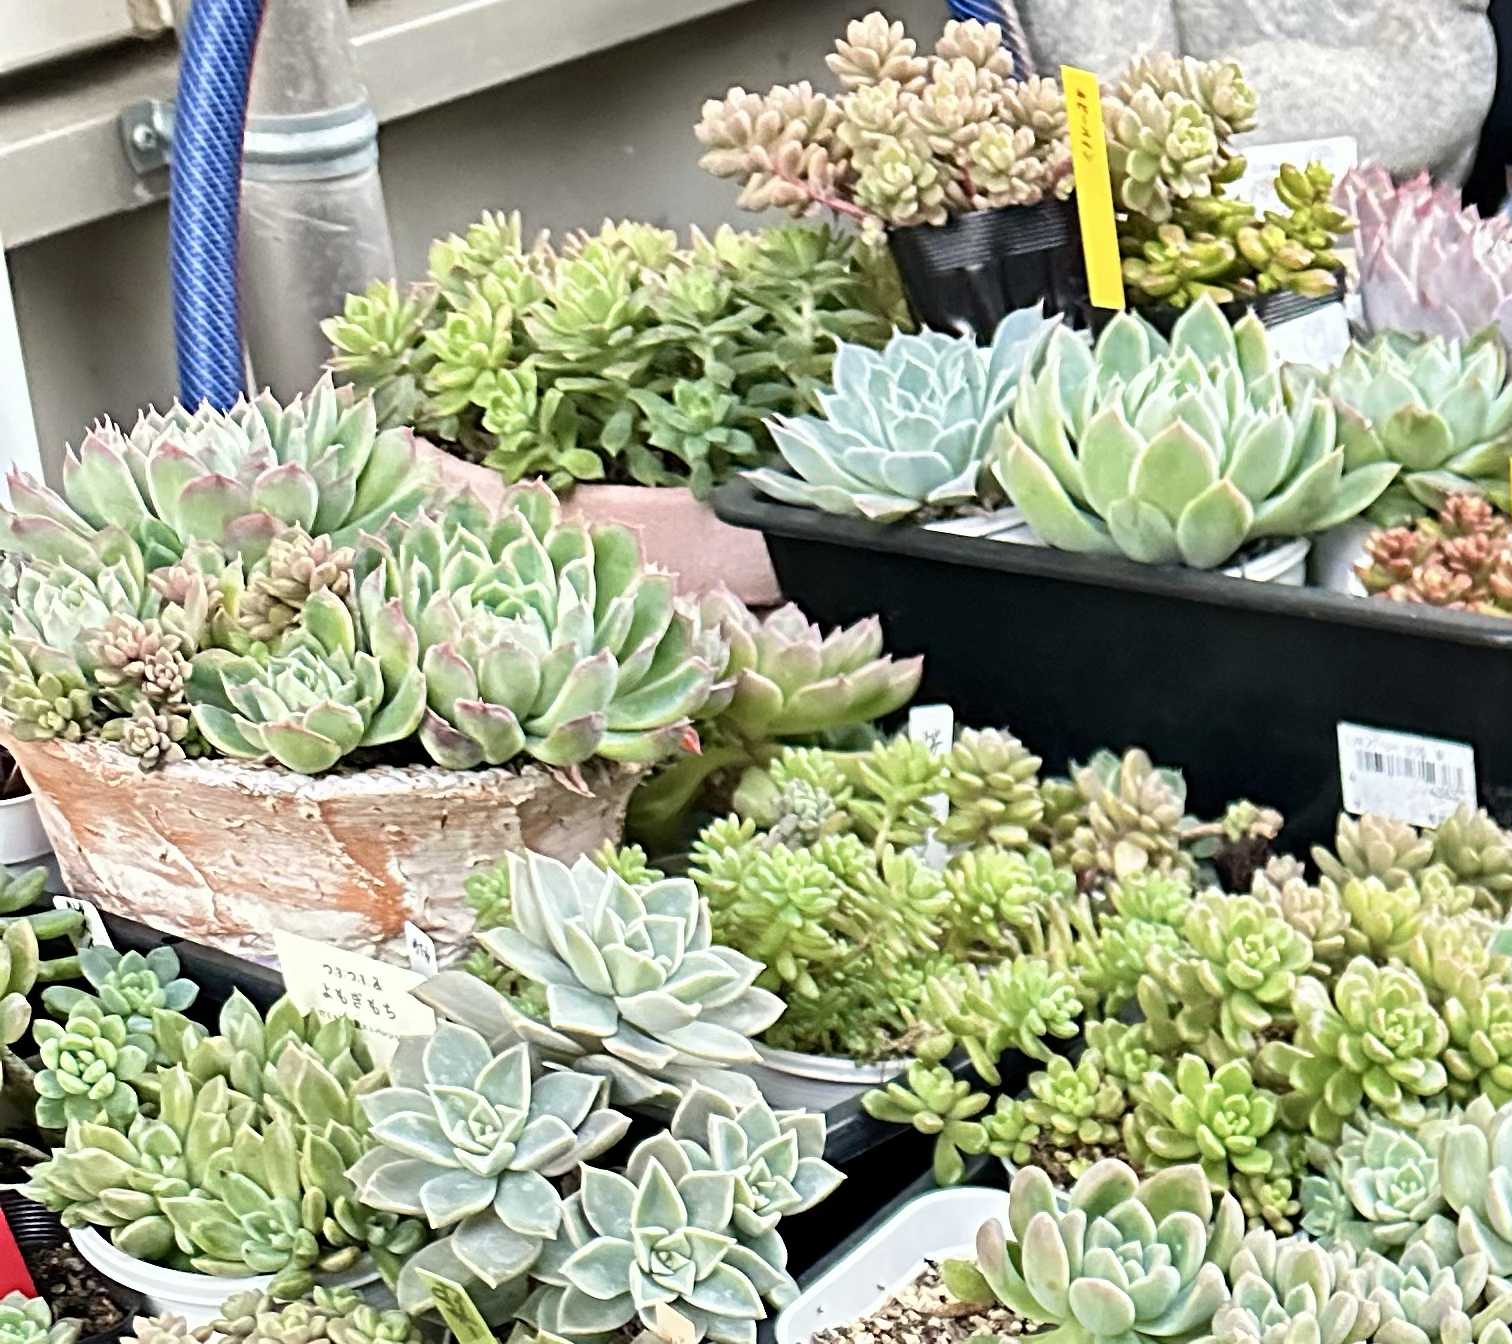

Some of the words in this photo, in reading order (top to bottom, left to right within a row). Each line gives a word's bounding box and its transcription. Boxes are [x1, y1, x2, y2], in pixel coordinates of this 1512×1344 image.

[322, 982, 397, 1021] よもぎもち
